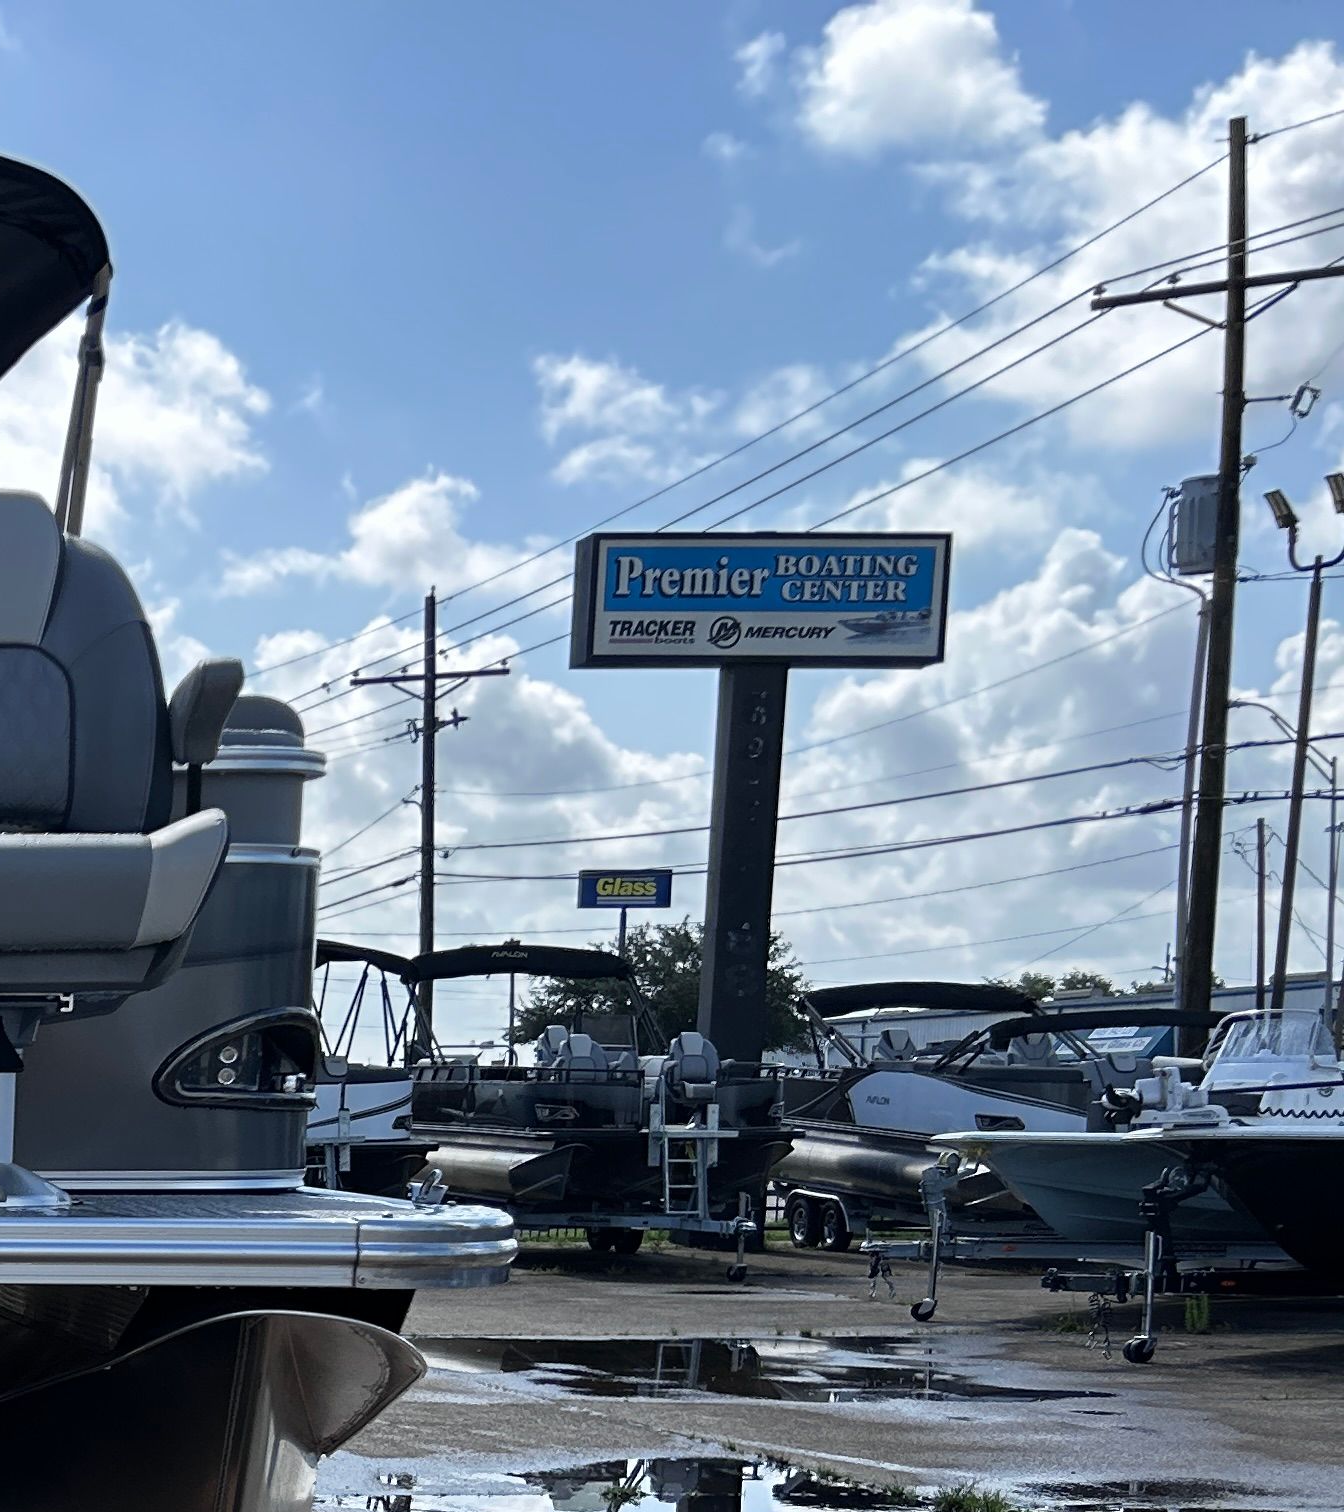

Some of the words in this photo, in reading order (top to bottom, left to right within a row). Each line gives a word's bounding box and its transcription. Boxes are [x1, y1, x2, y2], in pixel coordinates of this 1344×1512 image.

[615, 555, 771, 597] Premier
[775, 554, 918, 577] BOATING
[780, 580, 906, 602] CENTER
[609, 619, 696, 637] TRACKER
[744, 626, 835, 639] MERCURY
[595, 877, 657, 896] Glass
[491, 951, 528, 959] AVALON
